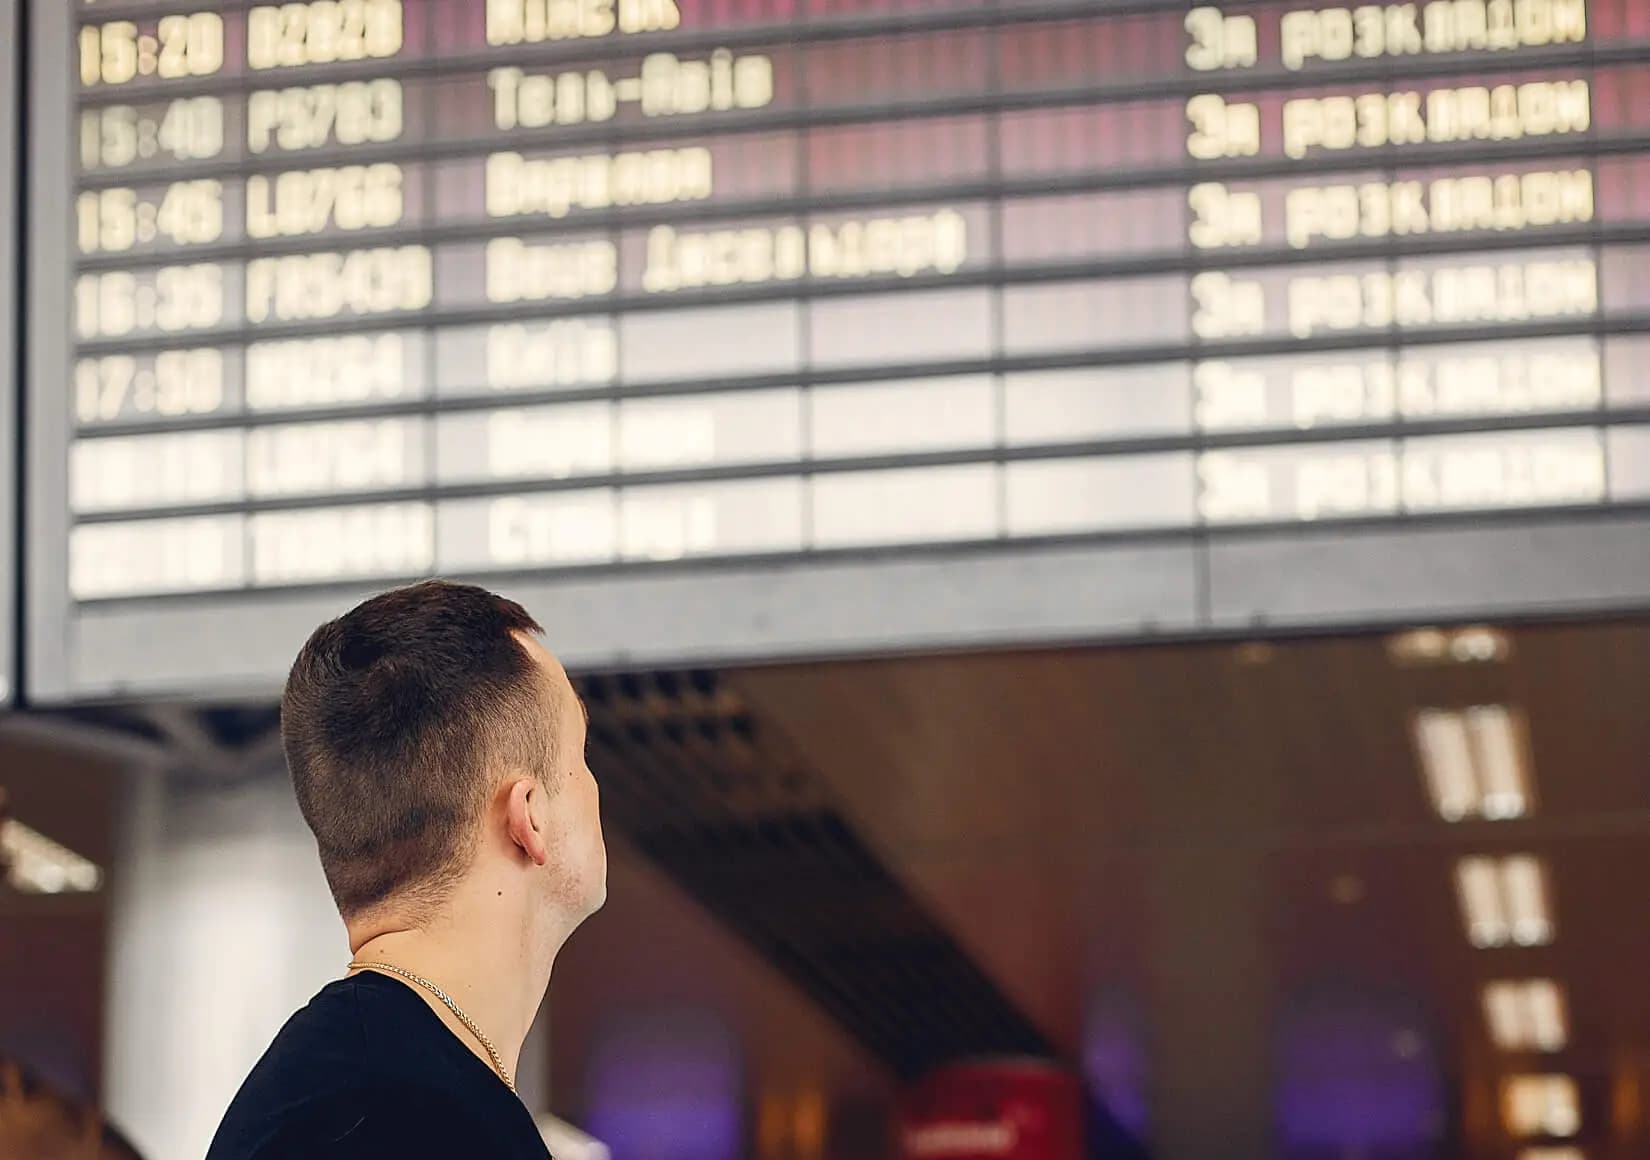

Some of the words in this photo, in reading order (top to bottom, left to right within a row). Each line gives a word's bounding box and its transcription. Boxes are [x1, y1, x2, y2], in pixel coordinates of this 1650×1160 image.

[80, 12, 223, 86] 15:20
[80, 96, 224, 170] 15:40
[77, 179, 223, 254] 15:45
